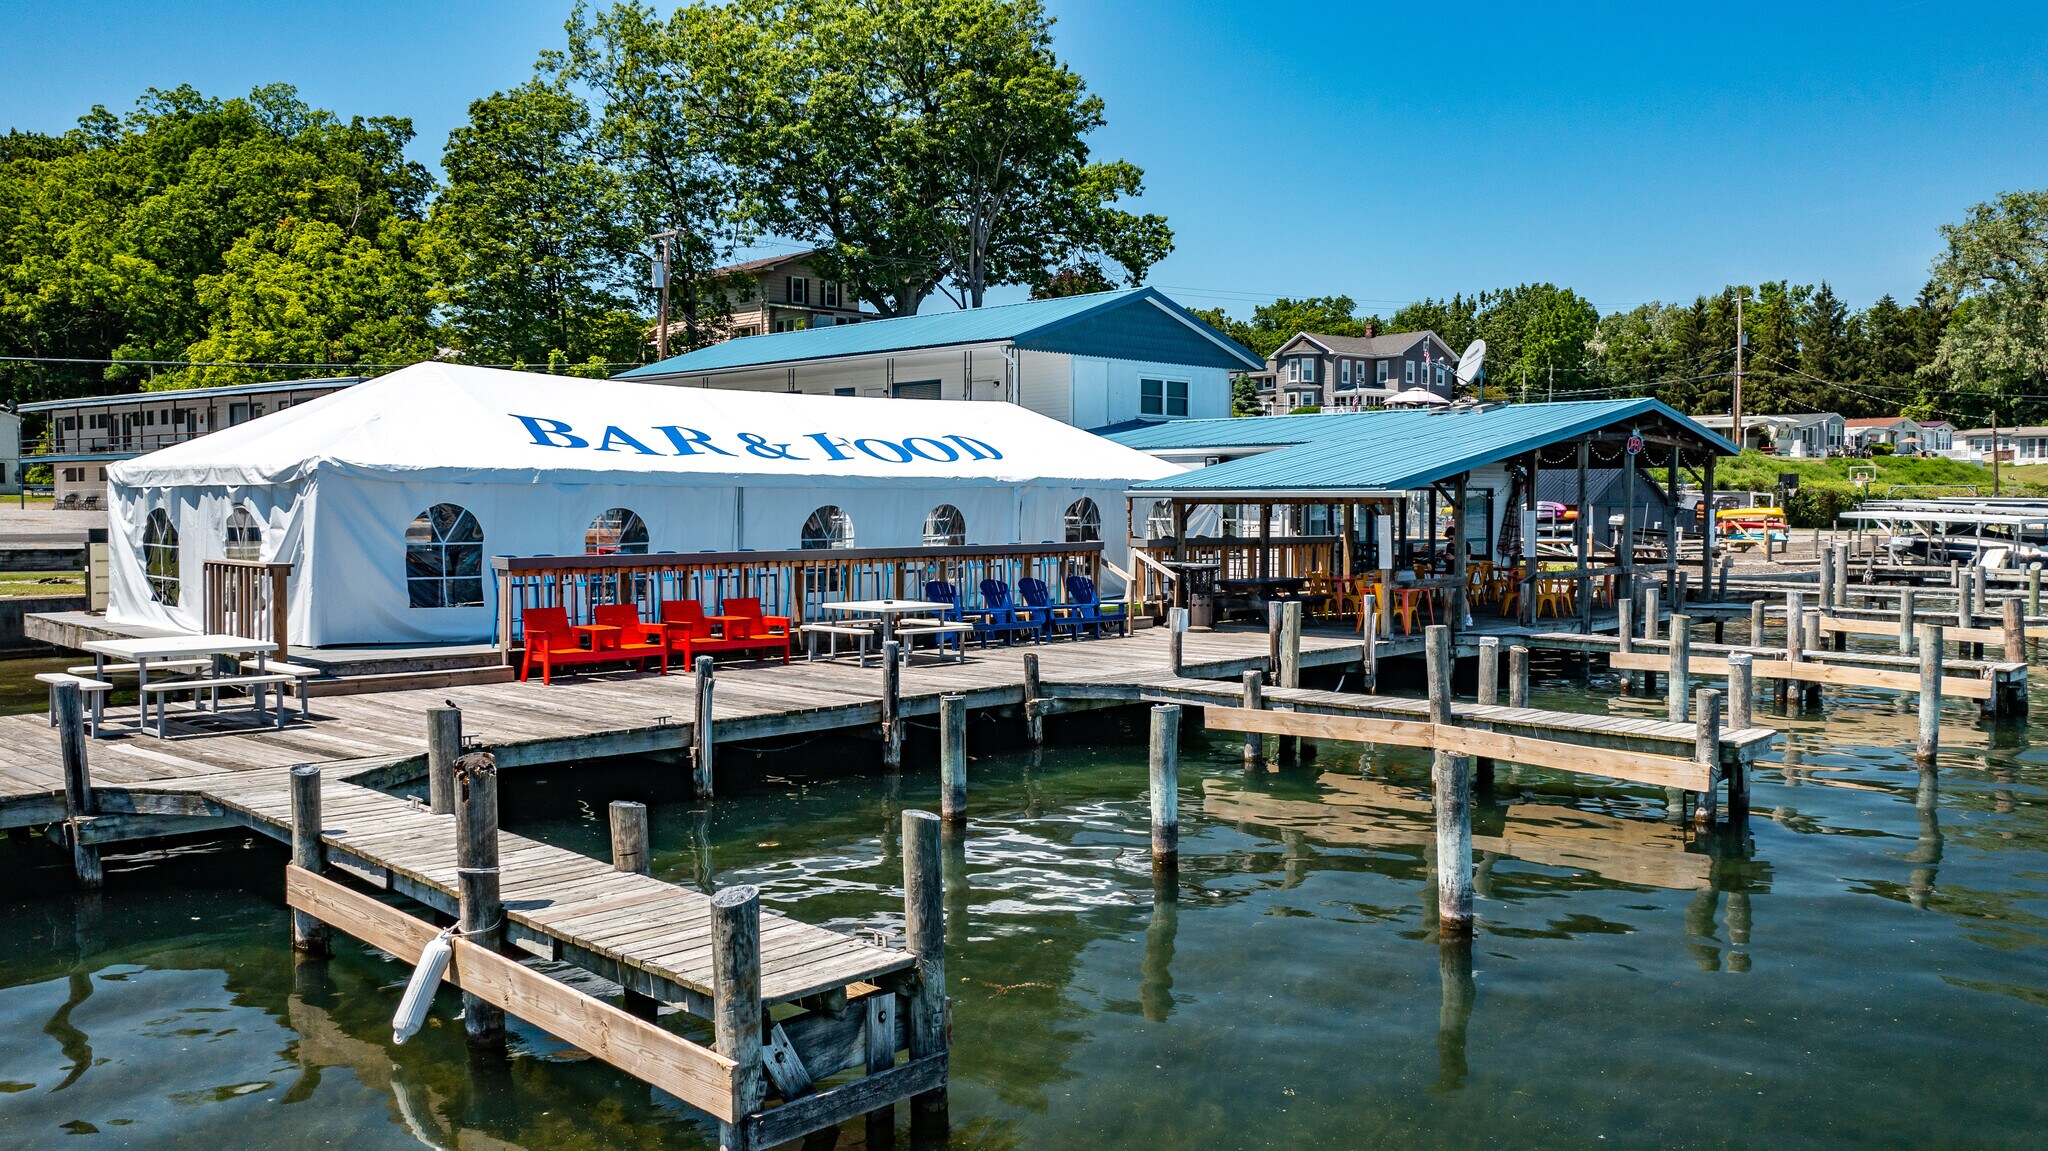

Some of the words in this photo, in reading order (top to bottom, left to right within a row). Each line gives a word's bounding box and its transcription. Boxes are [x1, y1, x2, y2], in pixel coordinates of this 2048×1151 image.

[508, 413, 739, 457] BAR
[736, 432, 809, 461] &
[803, 432, 1004, 463] FOOD
[1627, 436, 1642, 452] OPEN
